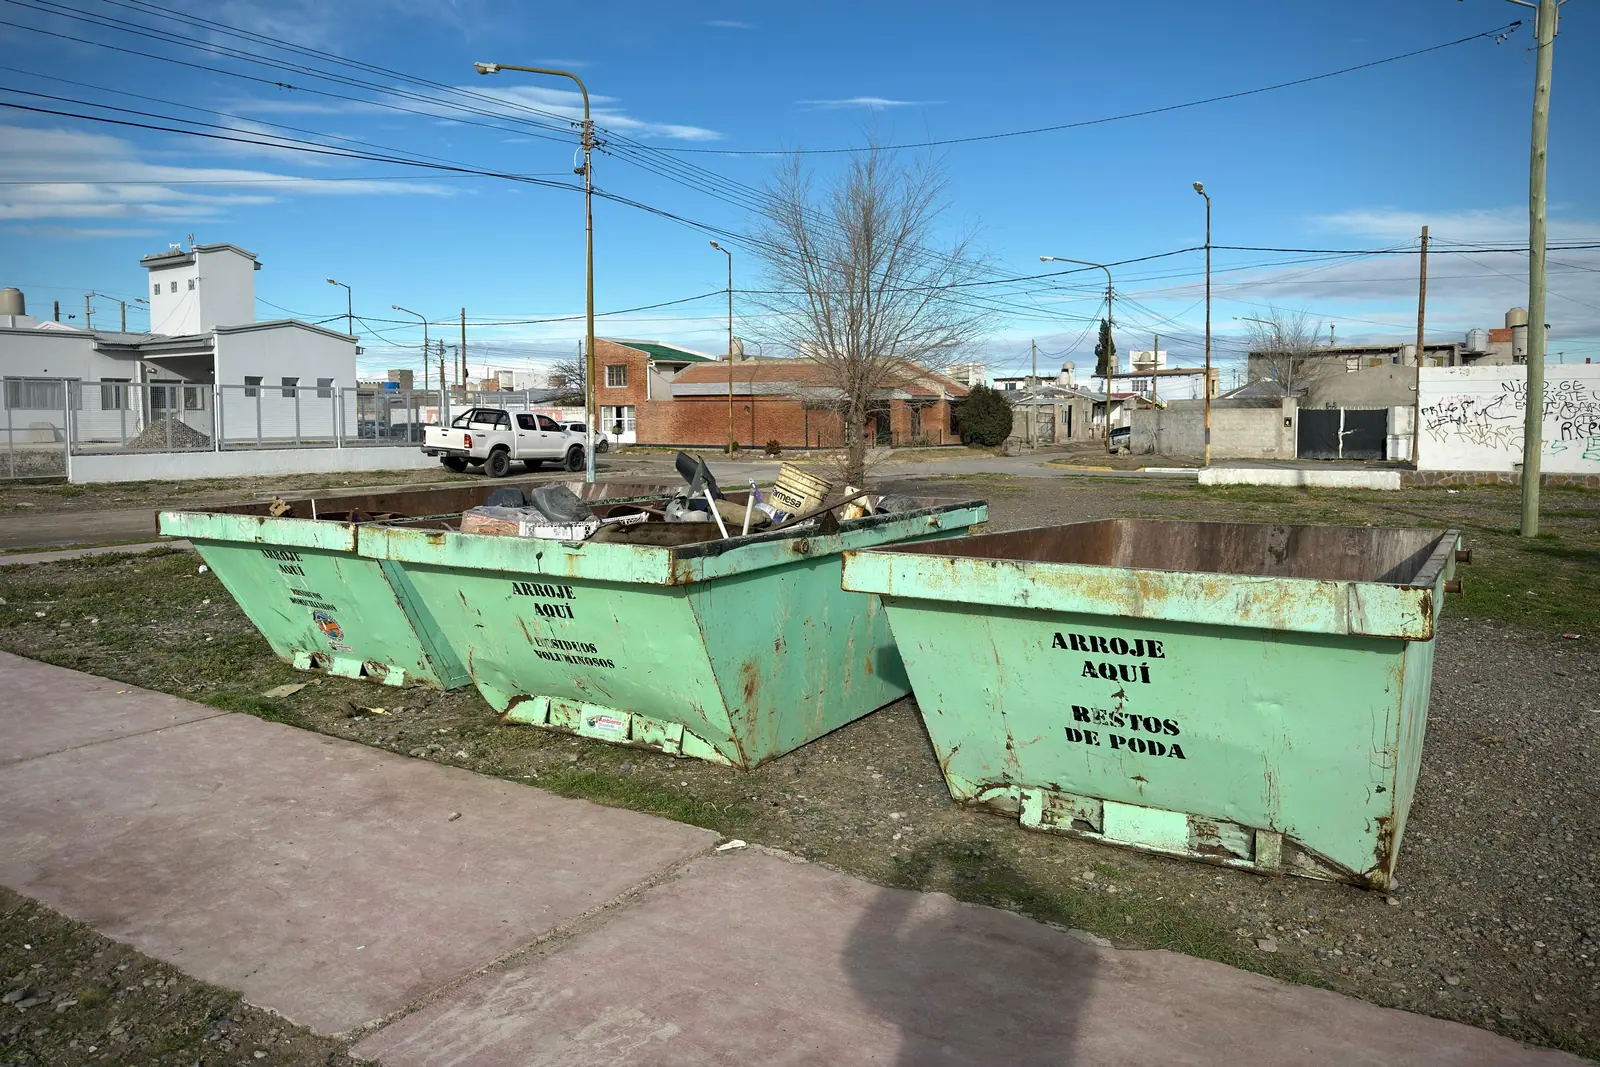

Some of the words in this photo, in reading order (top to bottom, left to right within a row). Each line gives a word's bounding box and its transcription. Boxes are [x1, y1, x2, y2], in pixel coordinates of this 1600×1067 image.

[772, 487, 802, 508] armesa
[512, 582, 576, 599] ARROJE
[1051, 632, 1165, 658] ARROJE
[1081, 660, 1151, 684] AQUÍ
[1071, 705, 1180, 736] RESTOS
[1064, 727, 1100, 746] DE
[1109, 734, 1186, 759] PODA
